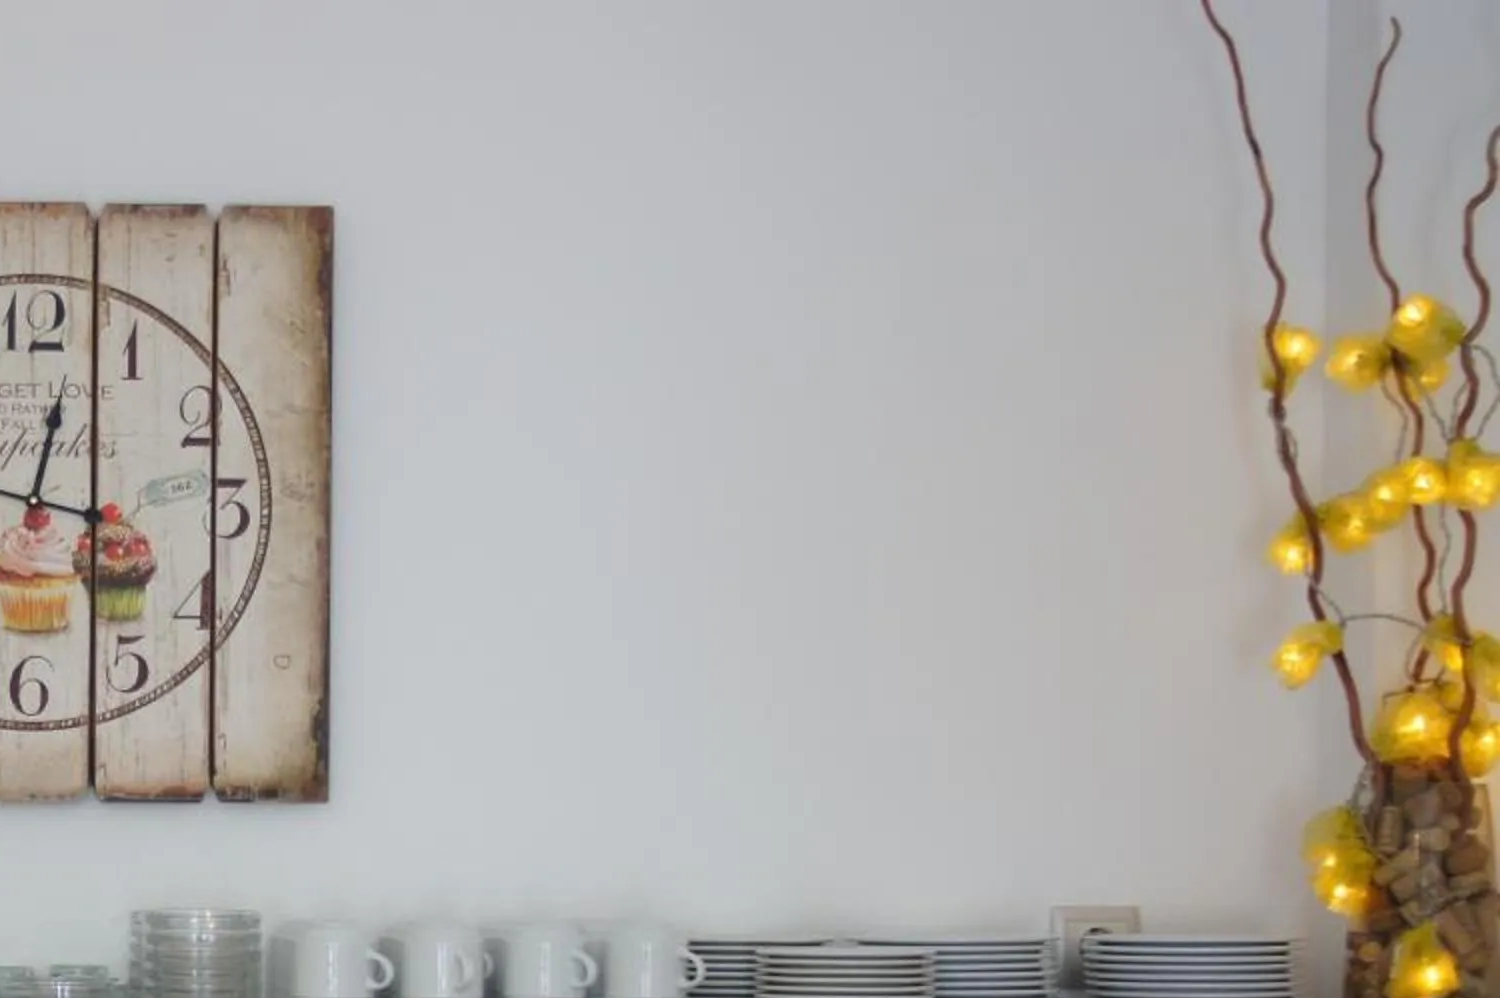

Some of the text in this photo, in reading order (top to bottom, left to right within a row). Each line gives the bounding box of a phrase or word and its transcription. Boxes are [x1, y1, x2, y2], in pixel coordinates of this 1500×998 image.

[1, 289, 66, 353] 12
[120, 318, 144, 381] 1
[11, 403, 67, 416] RATH
[48, 380, 115, 400] LOVE
[179, 385, 222, 449] 2
[203, 478, 250, 539] 3
[172, 566, 224, 631] 4
[9, 655, 55, 717] 6
[105, 633, 150, 694] 5
